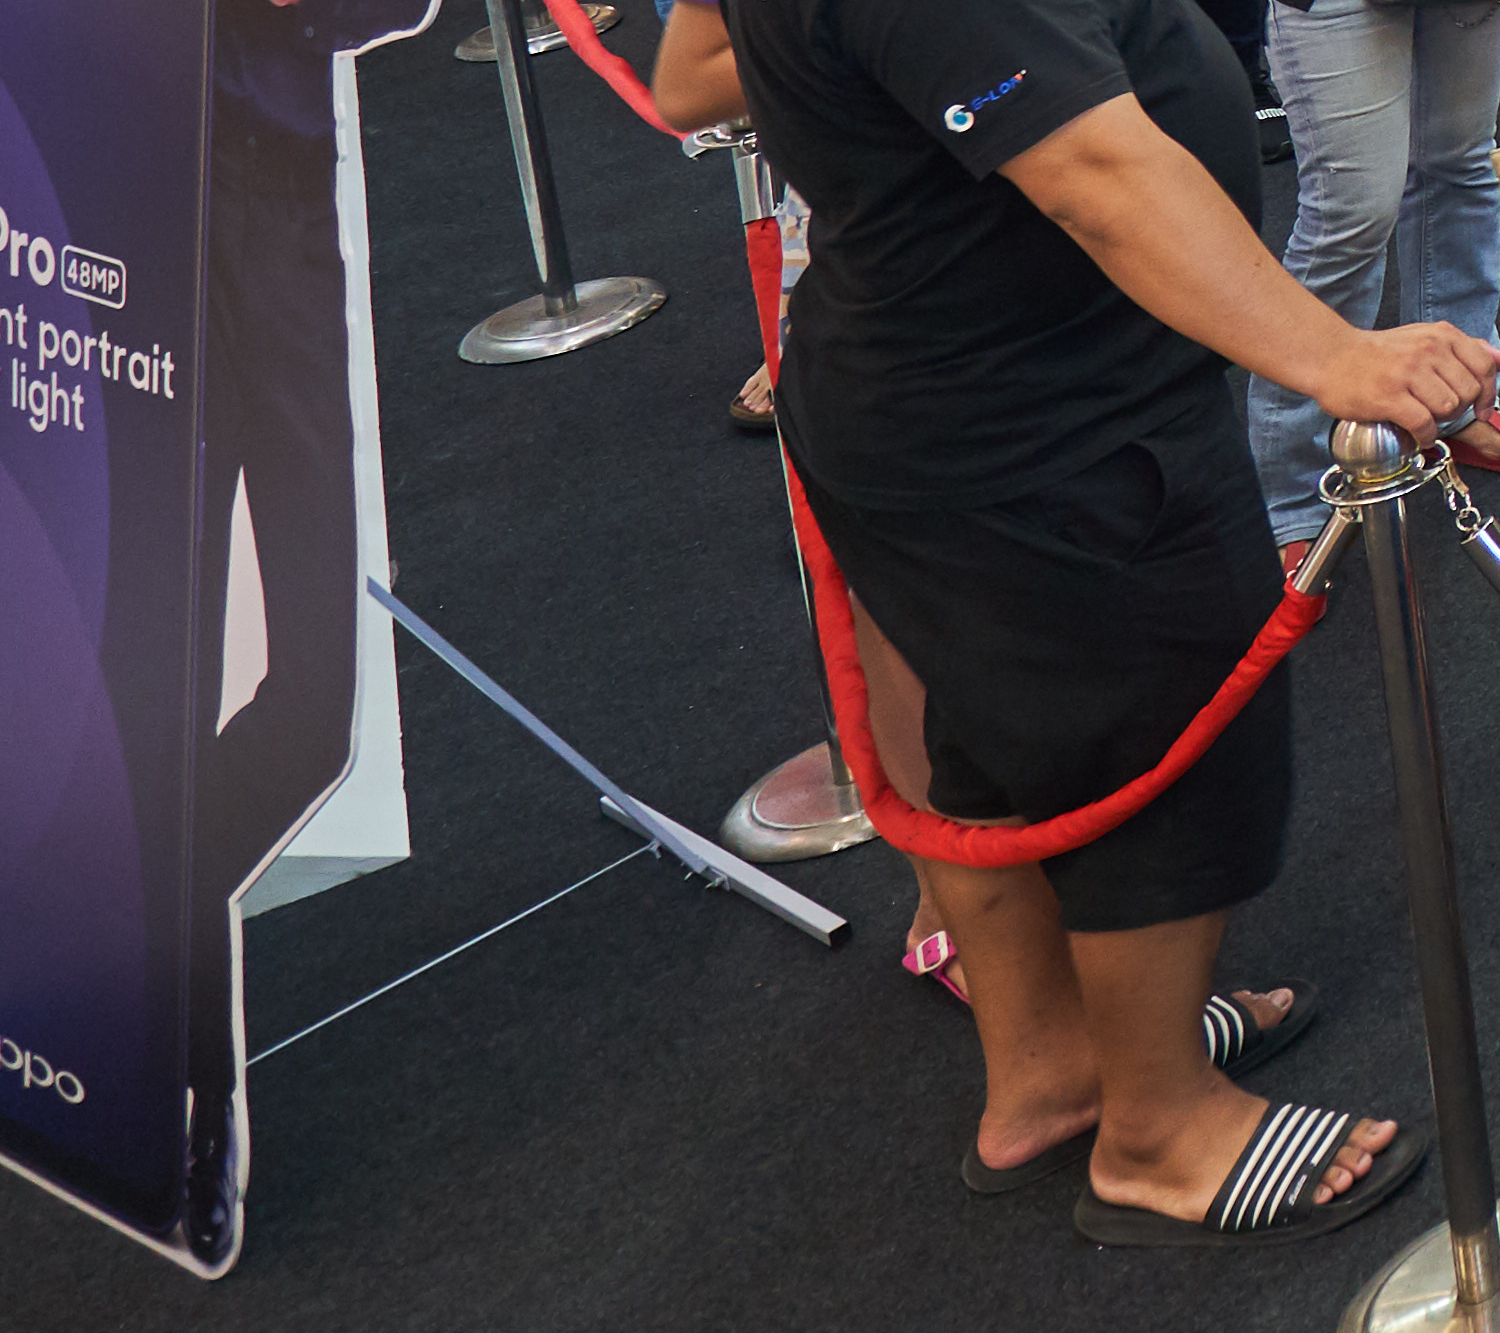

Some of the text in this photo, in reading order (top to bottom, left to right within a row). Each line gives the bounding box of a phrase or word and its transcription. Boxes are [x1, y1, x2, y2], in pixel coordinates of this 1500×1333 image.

[67, 257, 120, 296] 48MP
[12, 357, 85, 433] light
[39, 320, 175, 400] portrait
